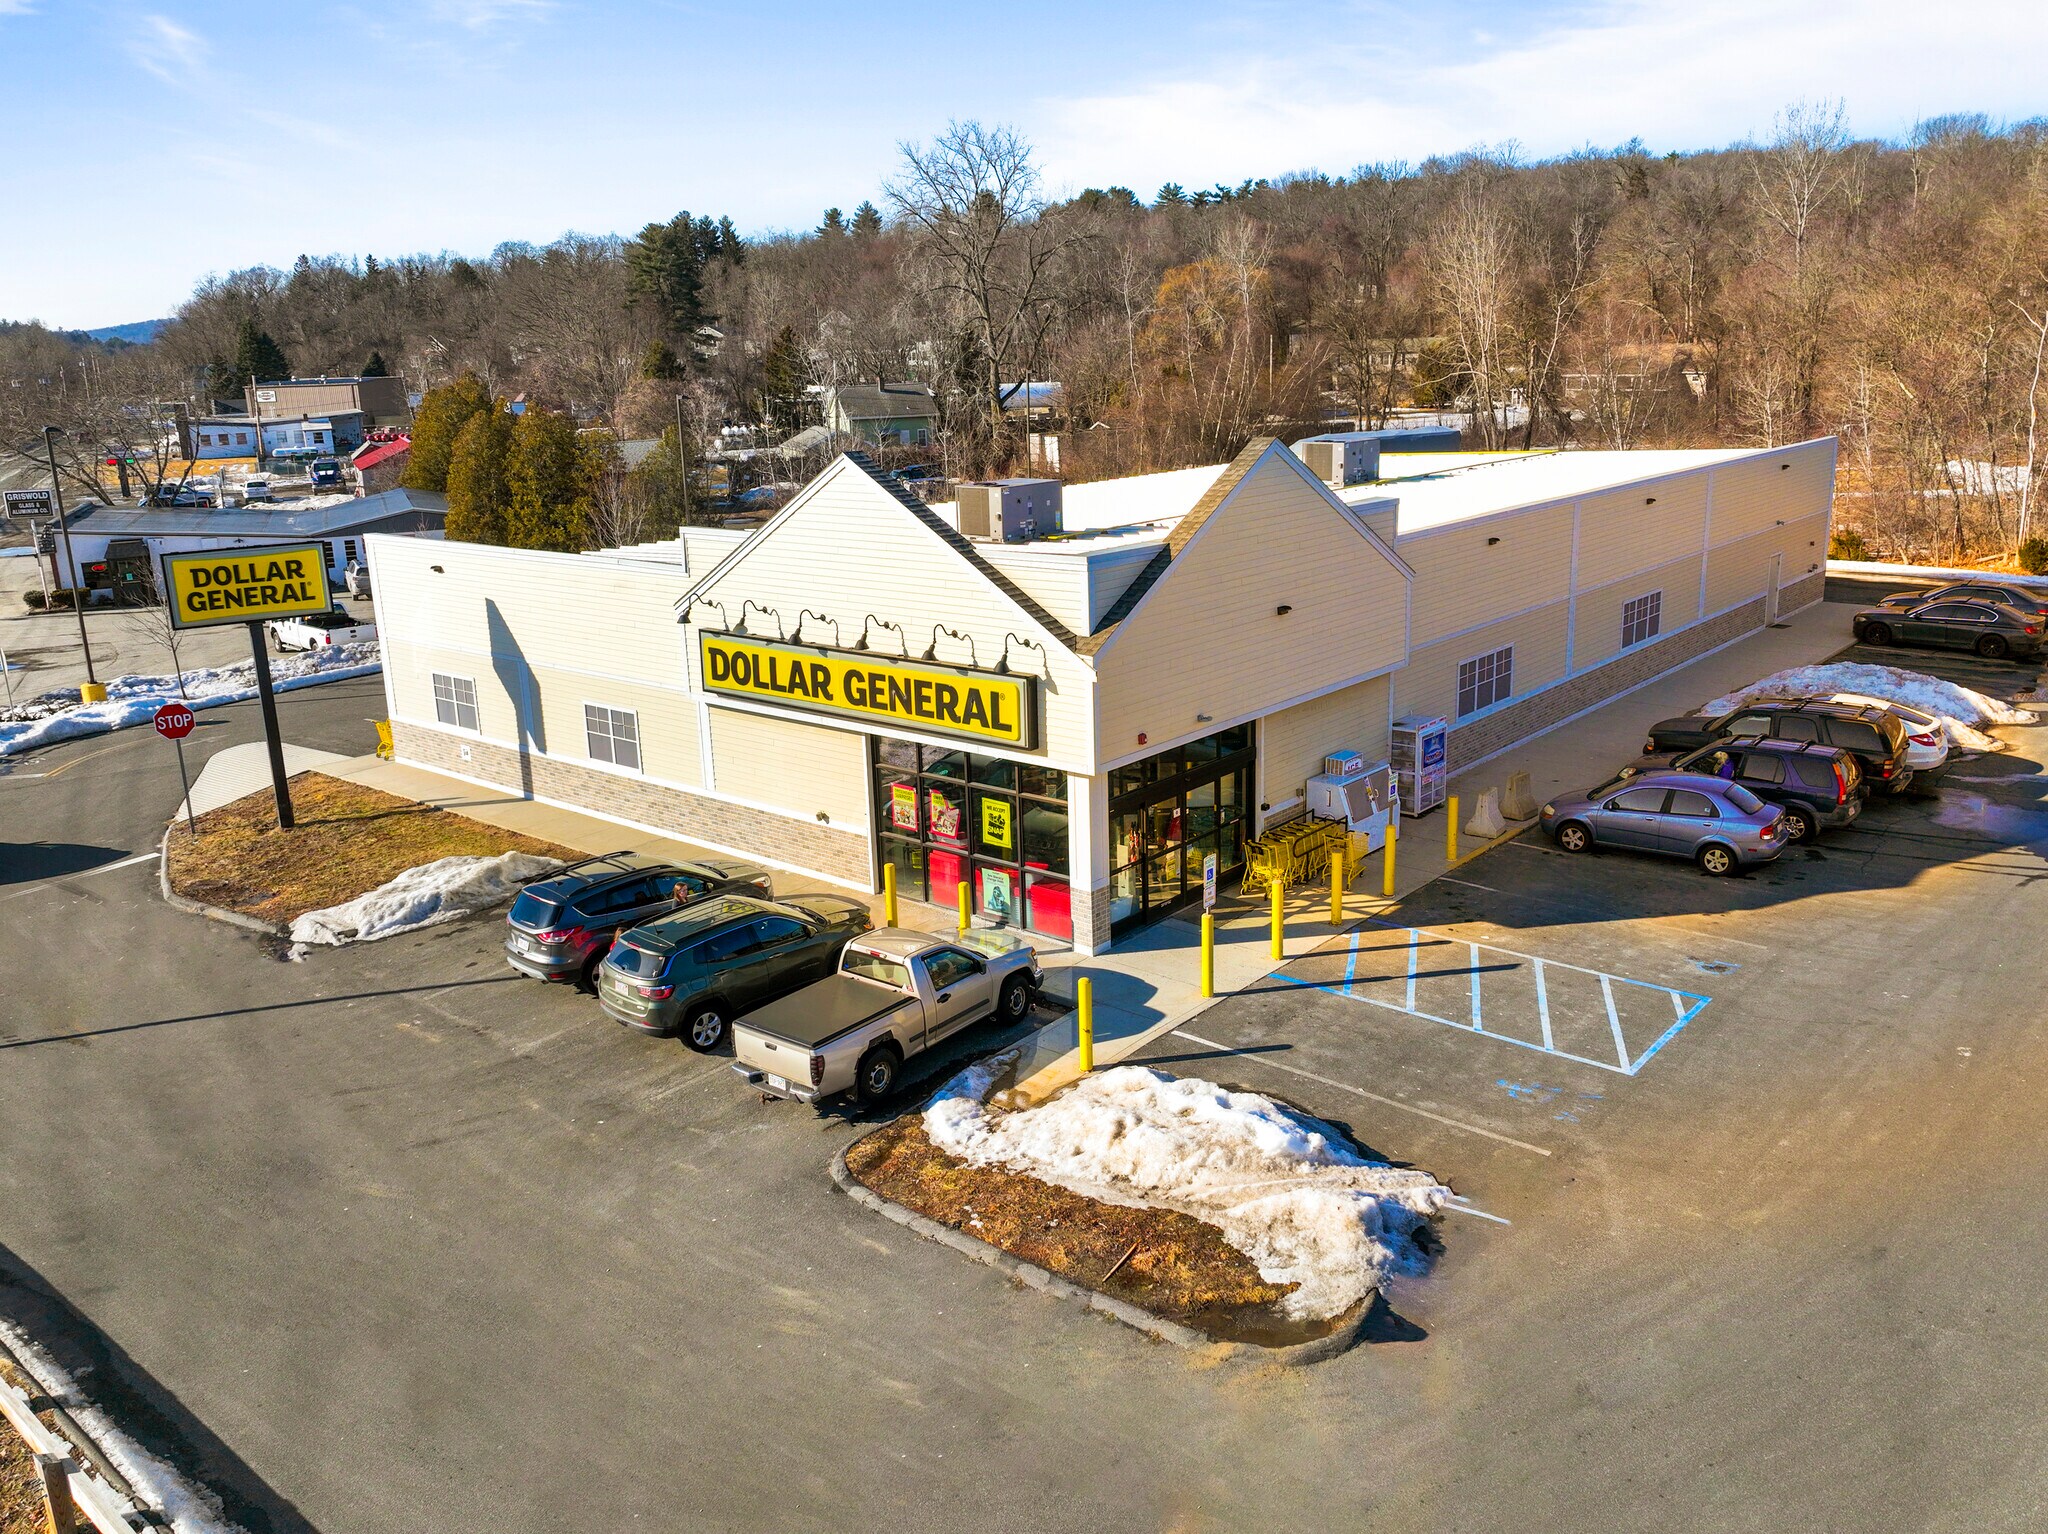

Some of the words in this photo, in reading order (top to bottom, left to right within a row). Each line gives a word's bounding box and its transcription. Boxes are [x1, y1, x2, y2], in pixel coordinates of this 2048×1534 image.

[6, 492, 48, 500] GRISWOLD
[189, 560, 305, 588] DOLLAR
[186, 582, 316, 613] GENERAL
[707, 647, 833, 701] DOLLAR
[843, 668, 1013, 732] GENERAL
[157, 713, 192, 730] STOP
[988, 826, 1004, 836] SNAP
